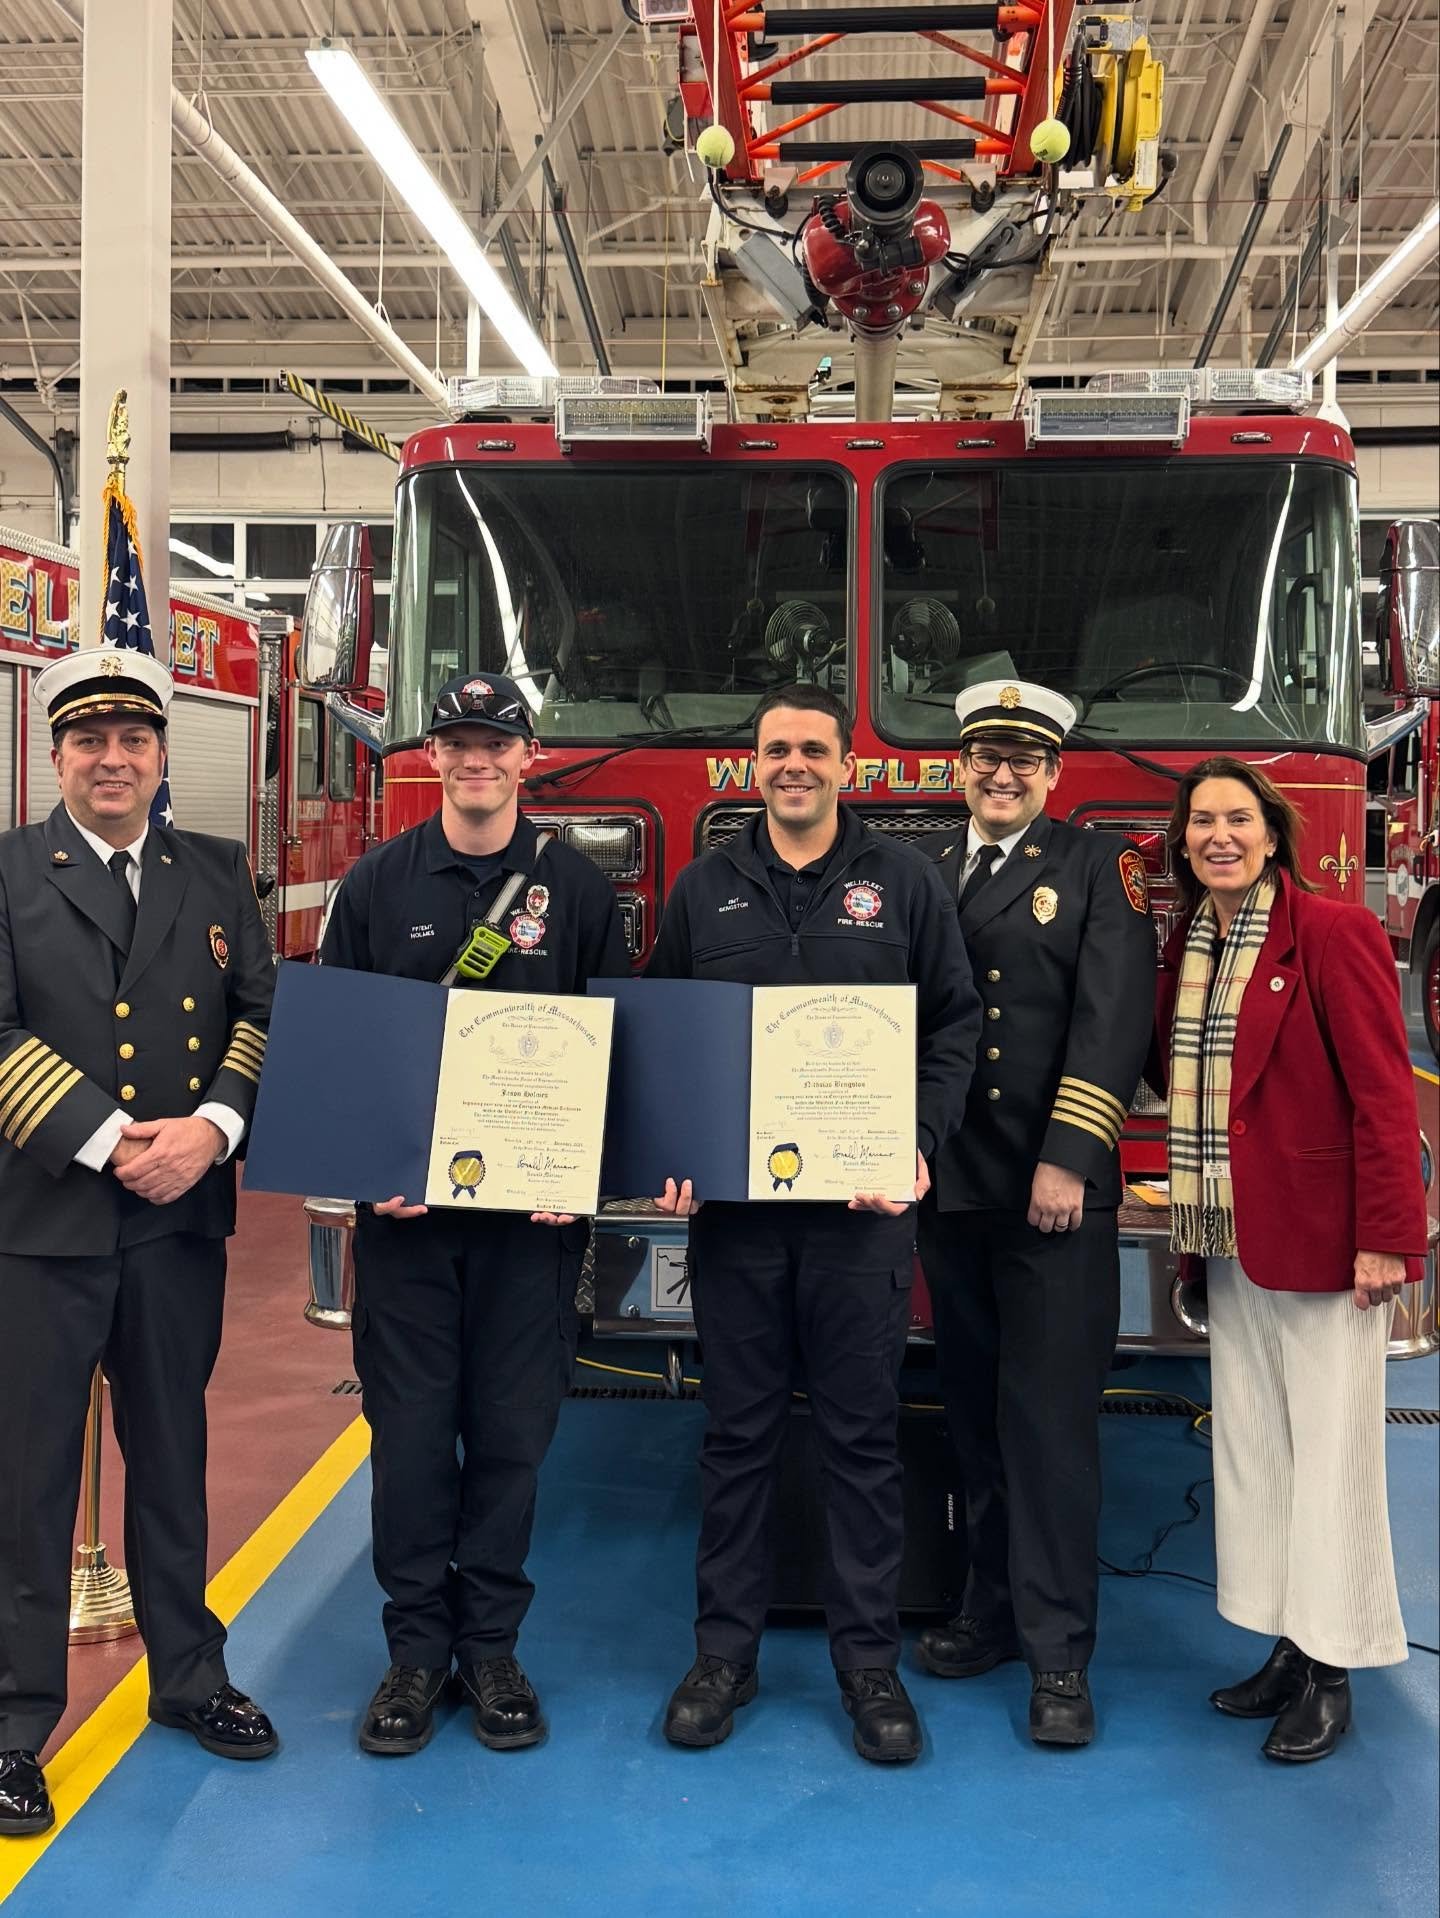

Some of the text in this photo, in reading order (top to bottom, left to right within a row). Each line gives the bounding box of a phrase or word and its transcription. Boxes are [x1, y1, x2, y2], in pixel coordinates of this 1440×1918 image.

[843, 880, 884, 892] WELLFLEET
[837, 918, 884, 928] FIRE RESCUE
[410, 929, 435, 940] HOLMES
[520, 948, 549, 956] RESCUE
[765, 993, 902, 1034] The Commonwealth of Massachusetts
[458, 1023, 475, 1038] The
[474, 1002, 535, 1026] Commonwealth
[538, 1003, 547, 1012] of
[546, 1004, 598, 1047] Massachusetts
